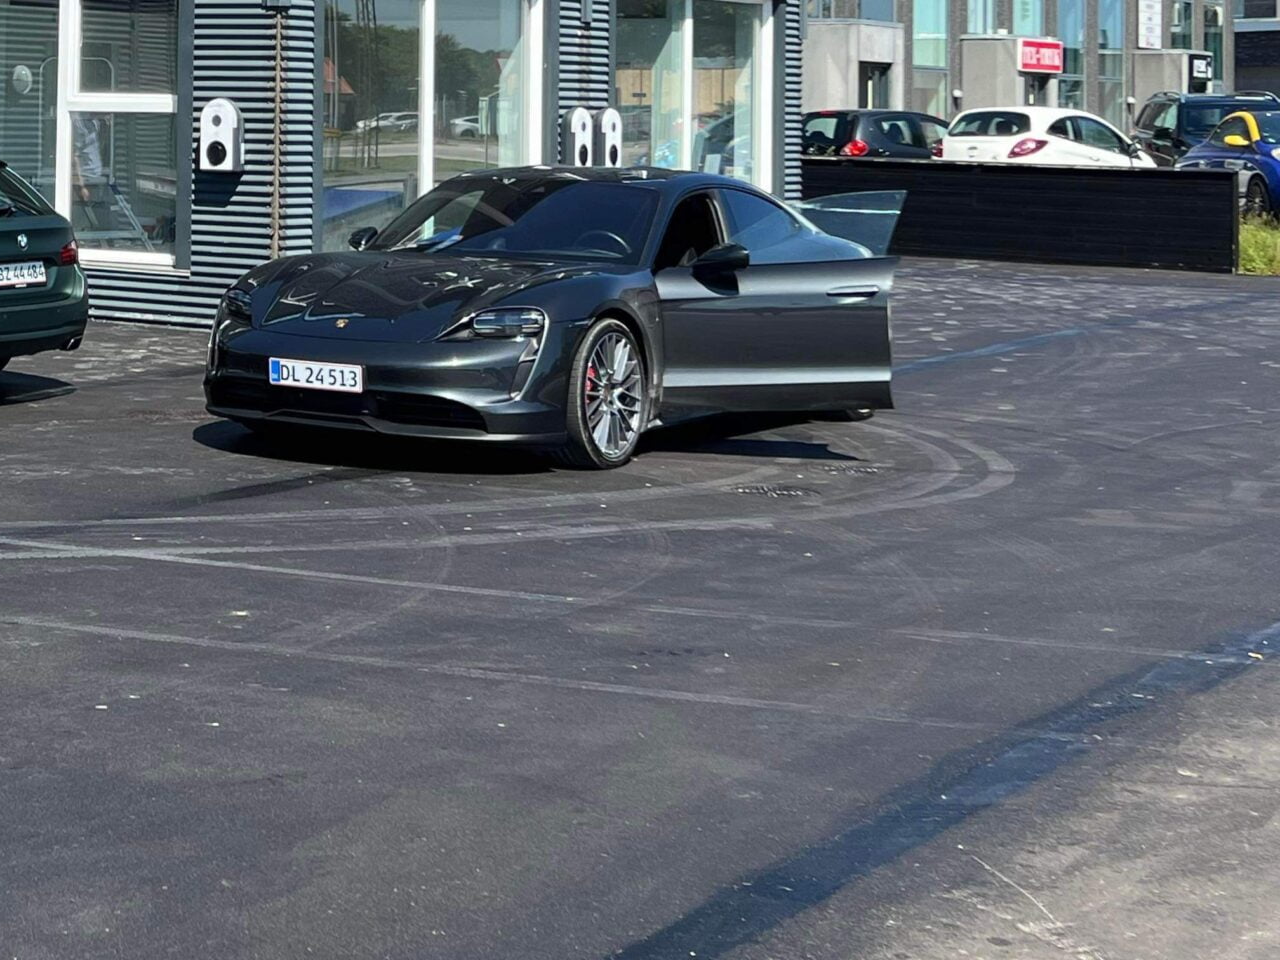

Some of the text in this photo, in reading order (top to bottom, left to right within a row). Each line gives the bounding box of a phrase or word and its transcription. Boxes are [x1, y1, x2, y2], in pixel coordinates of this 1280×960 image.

[14, 265, 25, 280] 44
[280, 365, 357, 387] DL 24 513
